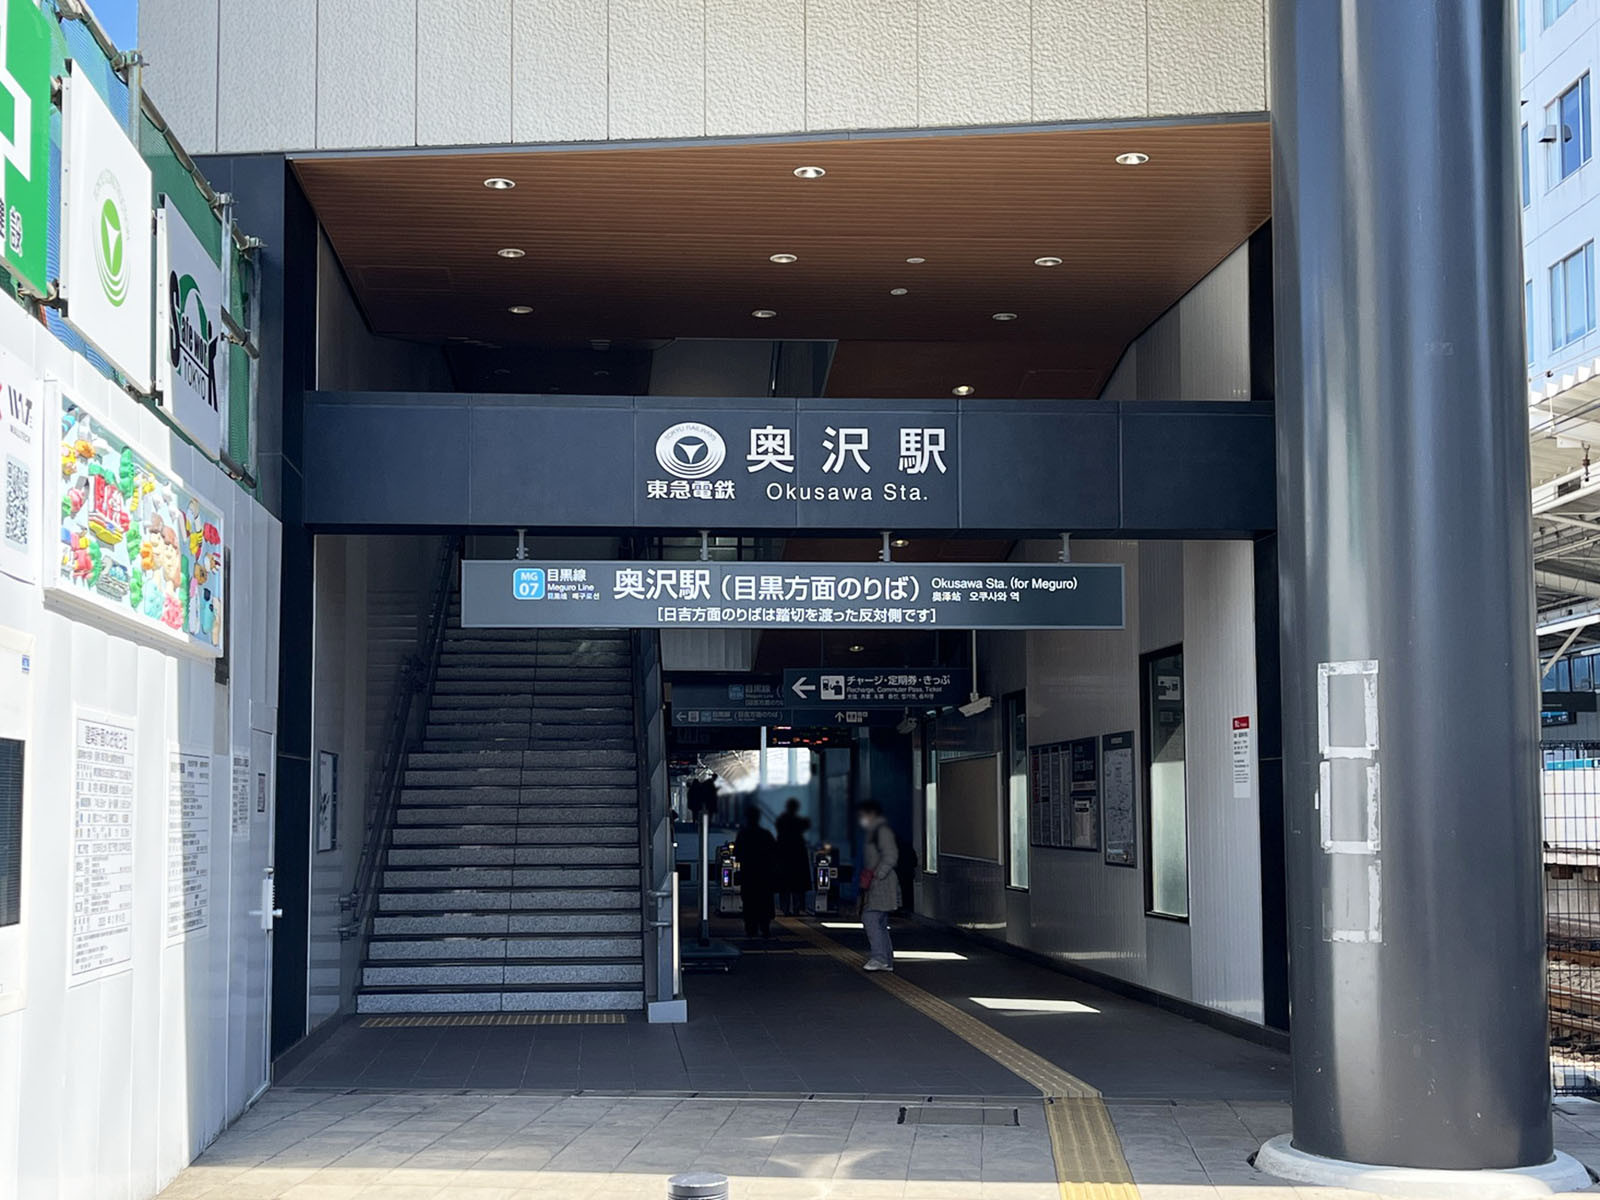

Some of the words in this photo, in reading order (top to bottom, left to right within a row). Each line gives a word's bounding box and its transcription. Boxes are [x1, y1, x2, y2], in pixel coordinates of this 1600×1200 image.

[183, 355, 207, 401] TOKYO
[746, 425, 947, 474] 奥沢駅
[646, 480, 736, 500] 東急電鉄
[766, 482, 873, 501] Okusawa
[883, 483, 928, 501] Sta.
[520, 571, 538, 582] MG
[547, 568, 587, 582] 目黒線
[519, 582, 539, 596] 07
[547, 583, 575, 593] Meguro
[577, 583, 595, 592] Line
[931, 577, 983, 590] Okusawa
[985, 578, 1008, 589] Sta.
[1010, 577, 1029, 590] (for
[1031, 577, 1078, 592] Meguro)
[968, 590, 1008, 602] 오쿠사와
[1010, 590, 1020, 602] 역
